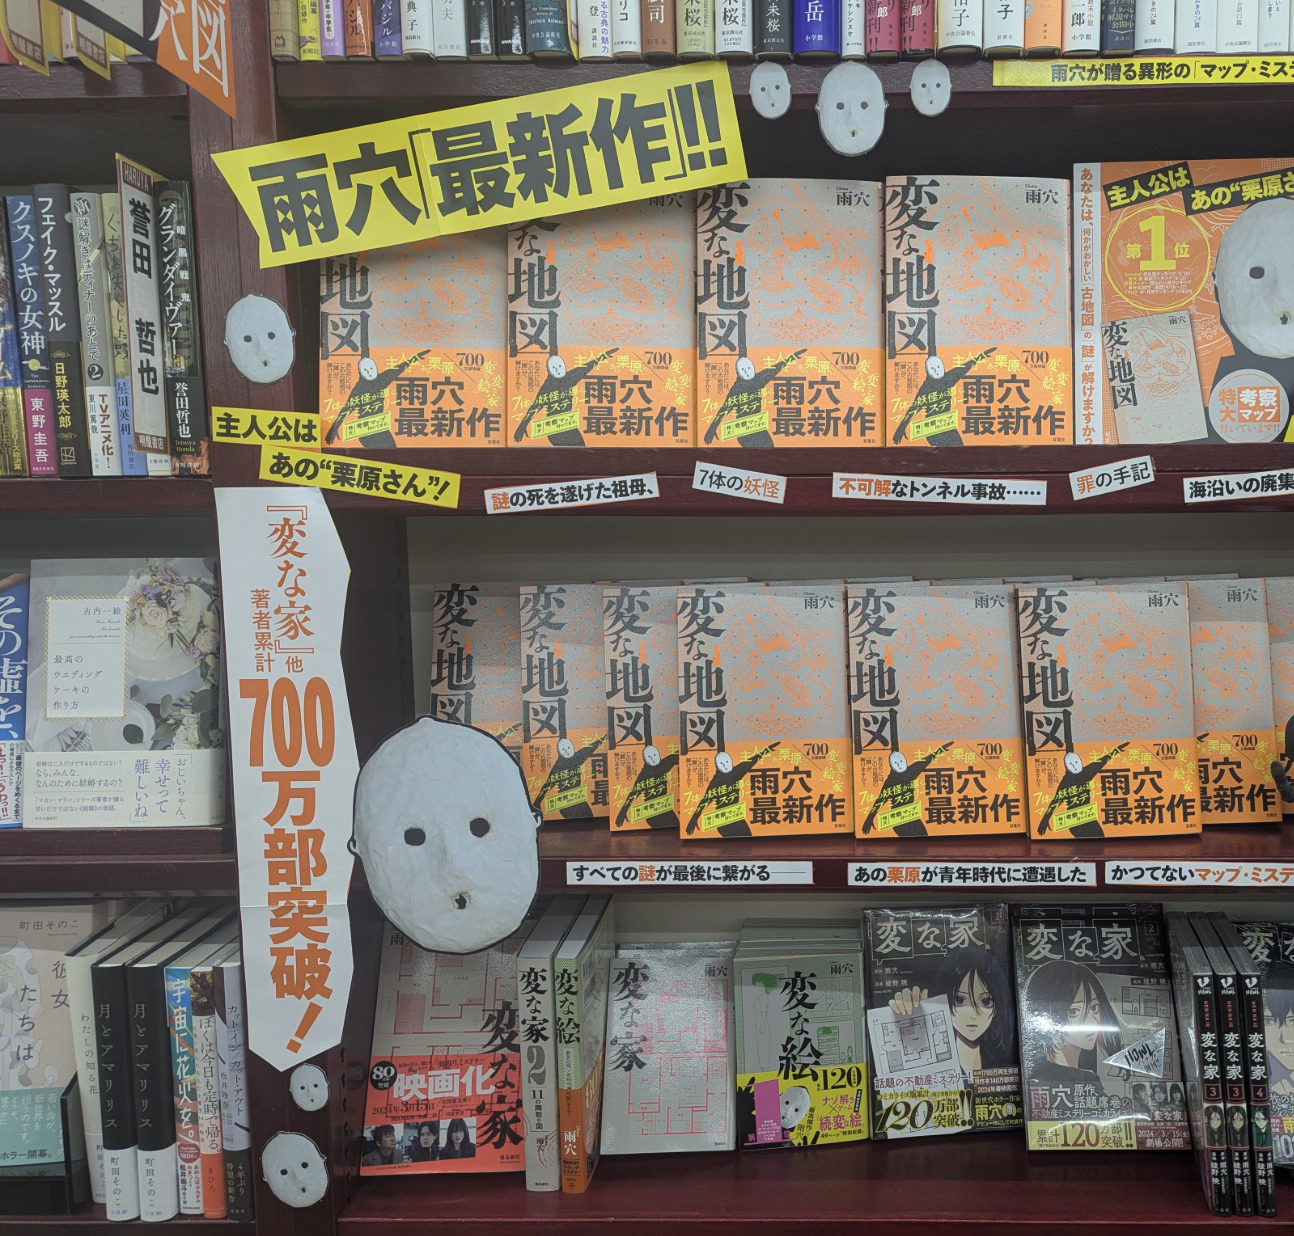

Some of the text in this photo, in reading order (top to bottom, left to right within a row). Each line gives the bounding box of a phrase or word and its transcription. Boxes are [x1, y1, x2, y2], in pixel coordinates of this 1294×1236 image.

[805, 34, 824, 42] 小学館
[1071, 33, 1092, 41] 小学館
[1111, 20, 1134, 29] 公開中
[123, 163, 149, 191] HARUYA
[1107, 166, 1192, 208] 主人公は
[836, 188, 871, 207] 雨穴
[1025, 187, 1060, 205] 雨穴
[12, 201, 46, 355] クスノキの女神
[37, 197, 67, 332] フェイク・マッスル
[158, 203, 183, 355] グランダイヴァー
[695, 181, 752, 361] 変な地図
[884, 175, 941, 361] 変な地図
[77, 217, 100, 363] 謎解きはディナーのあとで
[1168, 315, 1187, 326] 雨穴
[455, 352, 485, 367] 700
[643, 350, 673, 366] 700
[1100, 320, 1138, 410] 変な地図
[54, 362, 72, 429] 日野瑛太郎
[391, 376, 465, 407] 雨穴
[580, 374, 653, 405] 雨穴
[771, 375, 841, 406] 雨穴
[960, 373, 1031, 405] 雨穴
[1239, 388, 1278, 406] 考察
[116, 381, 131, 436] 星田英利
[174, 381, 192, 439] 誉田哲也
[582, 405, 690, 437] 最新作
[961, 404, 1066, 436] 最新作
[1219, 388, 1237, 423] 特大
[1239, 407, 1279, 422] マップ
[30, 397, 49, 463] 東野圭吾
[98, 393, 115, 470] TVアニメ化！
[215, 411, 318, 443] 主人公は
[394, 406, 502, 438] 最新作
[771, 406, 877, 438] 最新作
[1219, 423, 1281, 434] 付いています!!
[698, 467, 781, 499] 7体の妖怪
[1075, 462, 1152, 495] 罪の手記
[491, 478, 656, 512] 謎の死を遂げた祖母、
[83, 606, 122, 616] 古内一絵
[250, 588, 276, 673] 著者累計
[52, 669, 103, 680] ウエディング
[53, 654, 84, 665] 最高の
[677, 588, 728, 756] 変な地図
[848, 588, 901, 756] 変な地図
[1019, 588, 1074, 757] 変な地図
[52, 685, 90, 695] ケーキの
[52, 700, 80, 711] 作り方
[238, 675, 336, 769] 700
[35, 768, 81, 778] なら、みんな、
[155, 758, 171, 814] 幸せって
[749, 793, 847, 826] 最新作
[924, 794, 1021, 825] 最新作
[1100, 793, 1196, 827] 最新作
[854, 864, 1088, 885] あの栗原が青年時代に遭遇した
[19, 920, 80, 931] 町田そのこ
[875, 917, 985, 955] 変な家
[1026, 922, 1139, 961] 変な家
[829, 962, 854, 975] 雨穴
[554, 967, 582, 1045] 変な絵
[608, 961, 651, 1073] 変な家
[15, 984, 38, 1062] たちは
[777, 971, 825, 1083] 変な絵
[80, 1013, 99, 1095] わたしの知る花
[98, 1003, 118, 1128] 月とアマリリス
[133, 1003, 153, 1128] 月とアマリリス
[171, 978, 196, 1139] 宇宙に花火を。
[371, 1065, 395, 1080] 80
[377, 1081, 391, 1089] 突破
[392, 1064, 497, 1102] 映画化
[475, 1000, 525, 1150] 変な家
[822, 1065, 863, 1092] 120
[821, 1093, 856, 1105] ナゾ解き
[1073, 1084, 1099, 1097] 原作、
[1073, 1095, 1132, 1109] 話題席巻の
[1209, 1086, 1217, 1098] 3
[1232, 1086, 1240, 1098] 3
[1256, 1086, 1264, 1098] 4
[1035, 1128, 1060, 1144] 累計
[110, 1156, 122, 1207] 町田そのこ
[144, 1156, 156, 1207] 町田そのこ
[207, 1166, 217, 1192] まひろ
